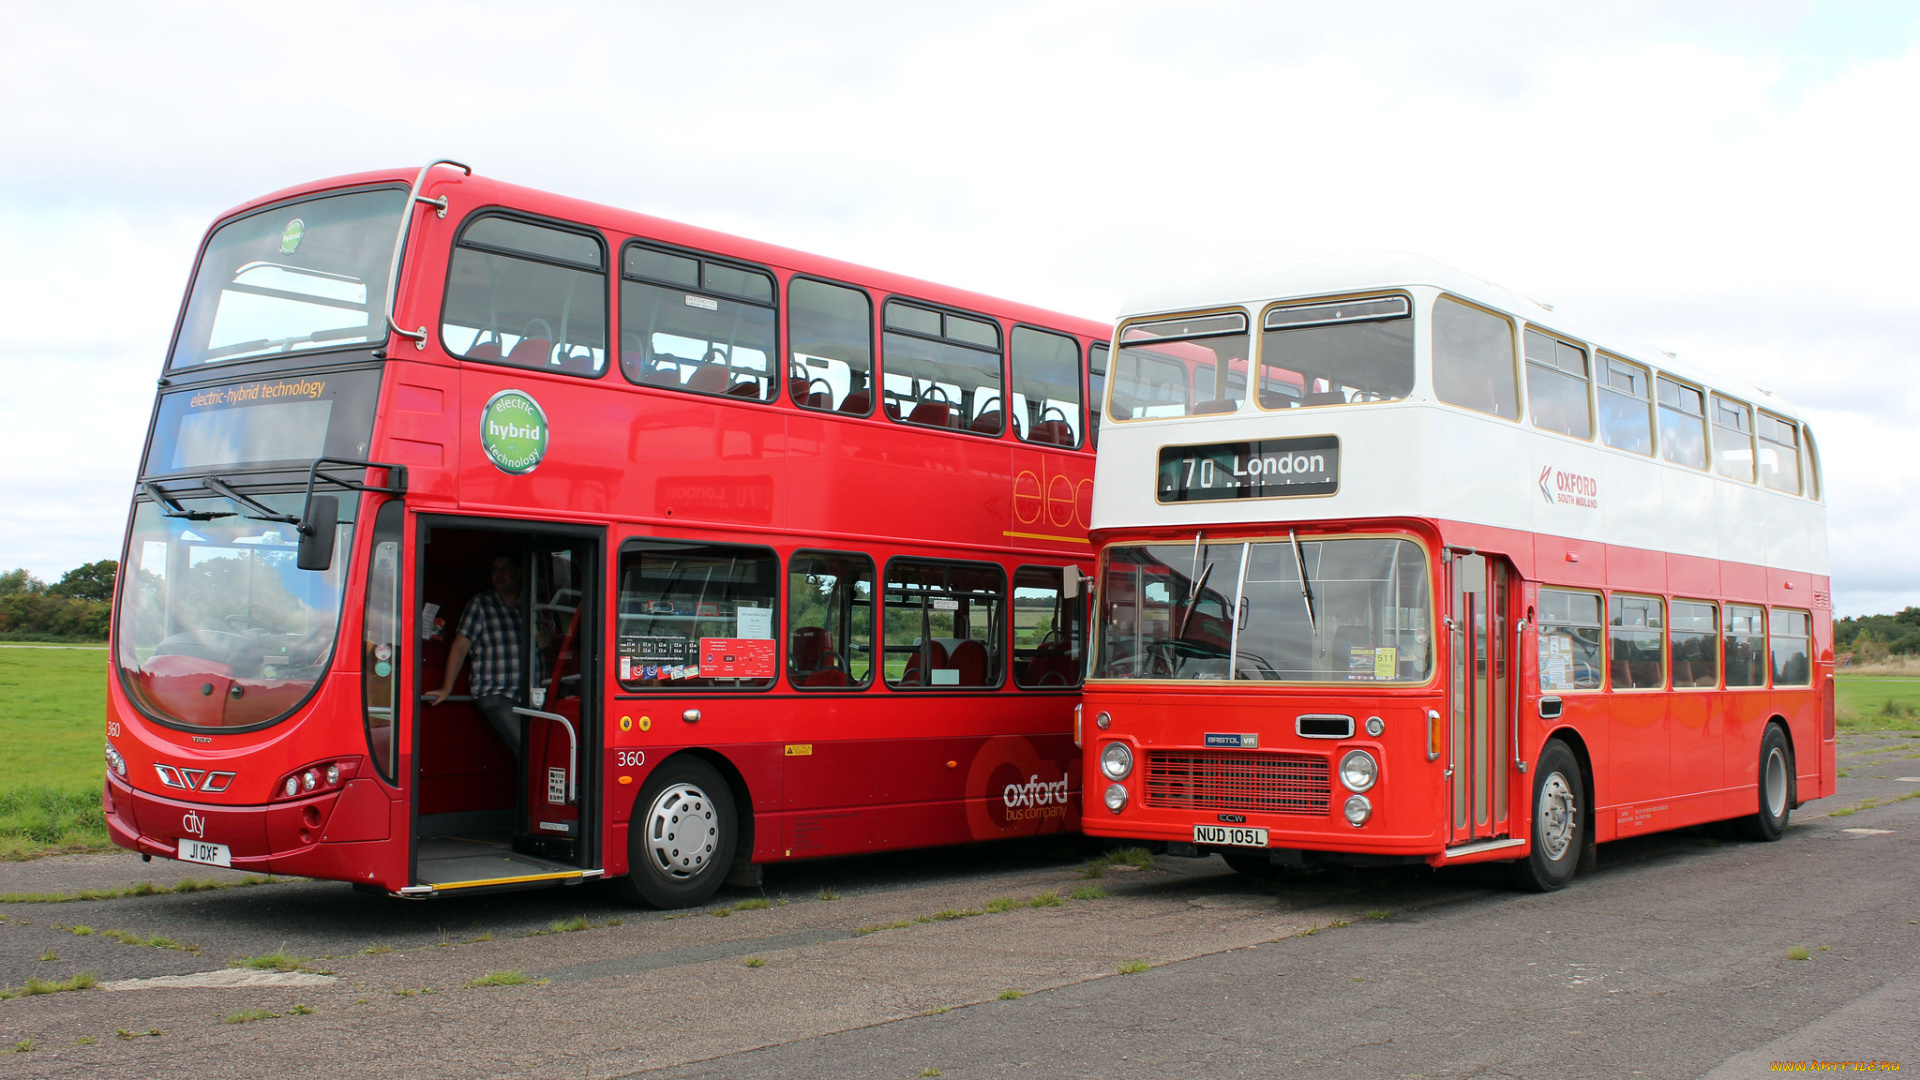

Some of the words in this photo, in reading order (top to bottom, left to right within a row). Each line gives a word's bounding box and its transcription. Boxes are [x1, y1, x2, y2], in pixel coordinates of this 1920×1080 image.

[190, 384, 260, 408] electric-hybrid
[261, 379, 326, 398] technology
[496, 397, 535, 416] electric
[489, 420, 540, 440] hybrid
[489, 443, 540, 468] technology
[1233, 452, 1325, 476] London
[1182, 458, 1215, 488] 70
[1556, 470, 1597, 497] OXFORD
[1558, 493, 1575, 504] SOUTH
[1576, 496, 1597, 508] MIDLAND
[1377, 654, 1394, 662] 511
[107, 721, 121, 738] 360
[1207, 736, 1240, 744] BRISTOL
[617, 750, 645, 767] 360
[1003, 772, 1068, 808] oxford
[1006, 807, 1023, 821] bus
[1025, 805, 1067, 820] company
[1219, 814, 1243, 822] ECW
[183, 810, 205, 838] city
[1197, 827, 1226, 842] NUD
[1229, 829, 1264, 845] 105L
[200, 845, 218, 861] OXF
